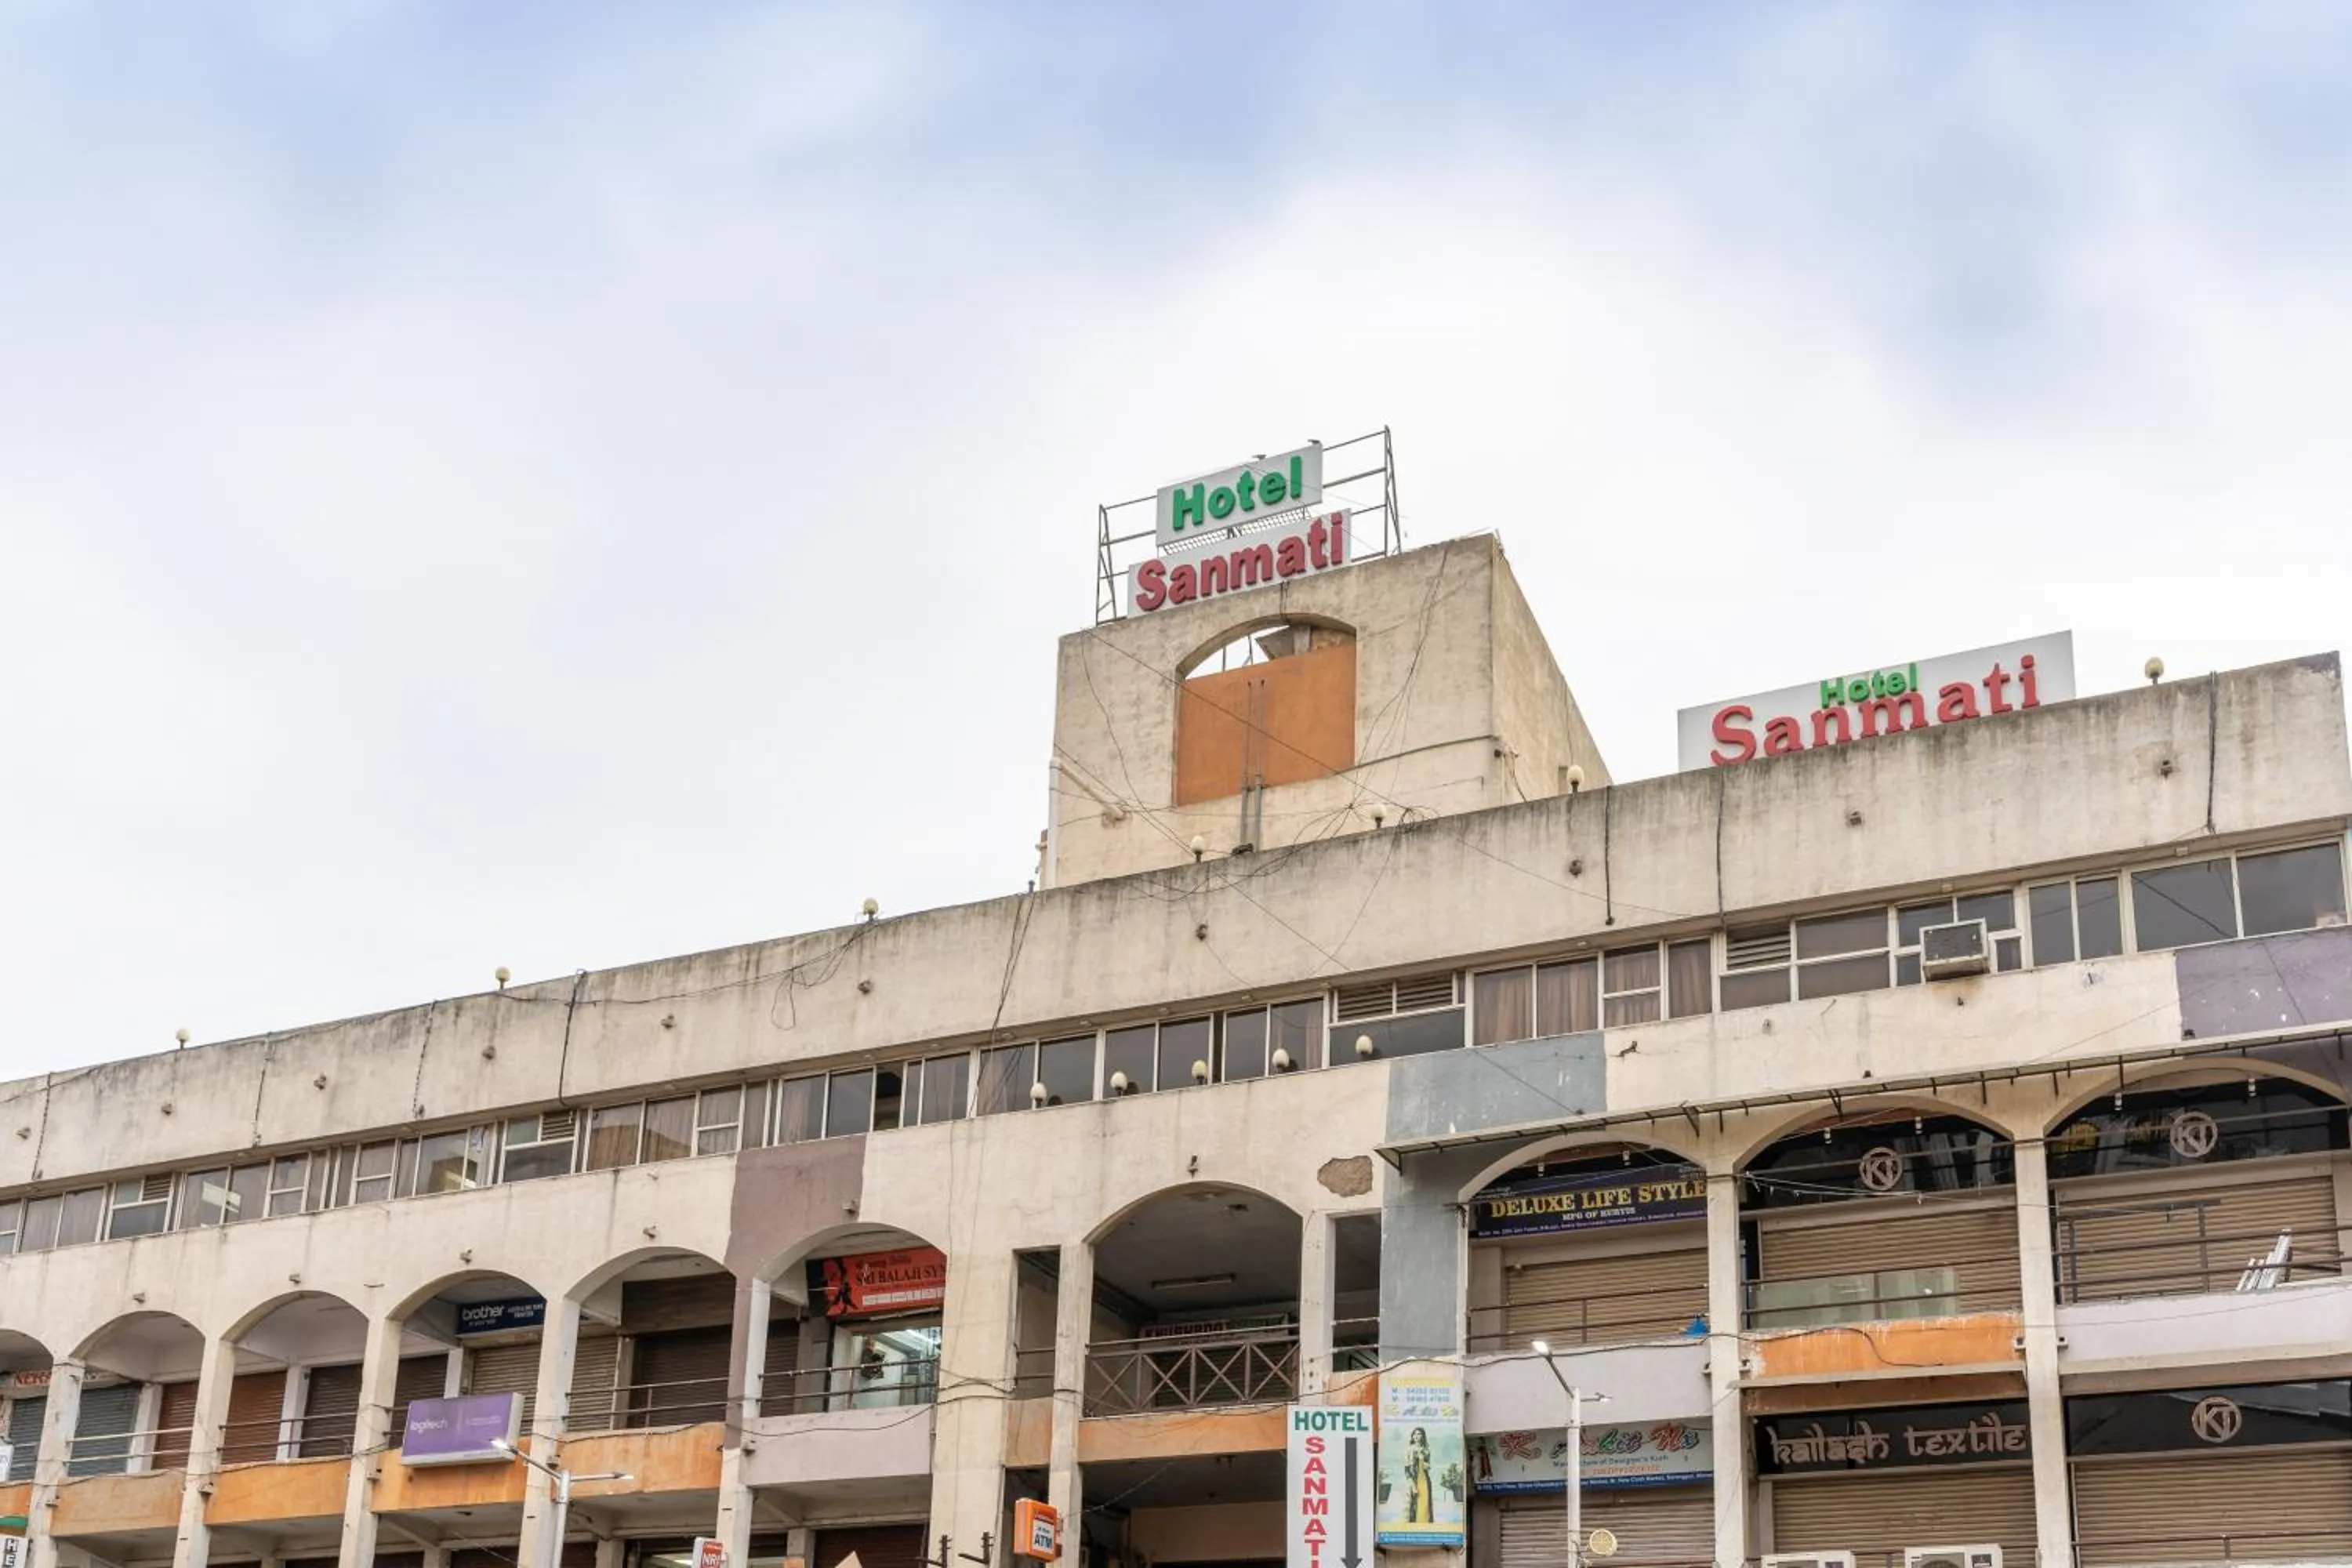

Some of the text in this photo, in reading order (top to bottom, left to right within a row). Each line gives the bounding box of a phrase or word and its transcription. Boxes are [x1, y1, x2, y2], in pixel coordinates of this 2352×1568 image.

[1173, 456, 1302, 531] Hotel
[1136, 511, 1344, 611] Sanmati
[1820, 662, 1918, 709] Hotel
[1710, 654, 2040, 766] Sanmati
[1490, 1180, 1707, 1218] DELUXE LIFE STYLE
[878, 1266, 921, 1284] BALAJI
[1294, 1411, 1369, 1432] HOTEL
[1904, 1412, 2027, 1456] textile
[1302, 1436, 1329, 1568] SANMATI
[1034, 1533, 1052, 1548] ATM
